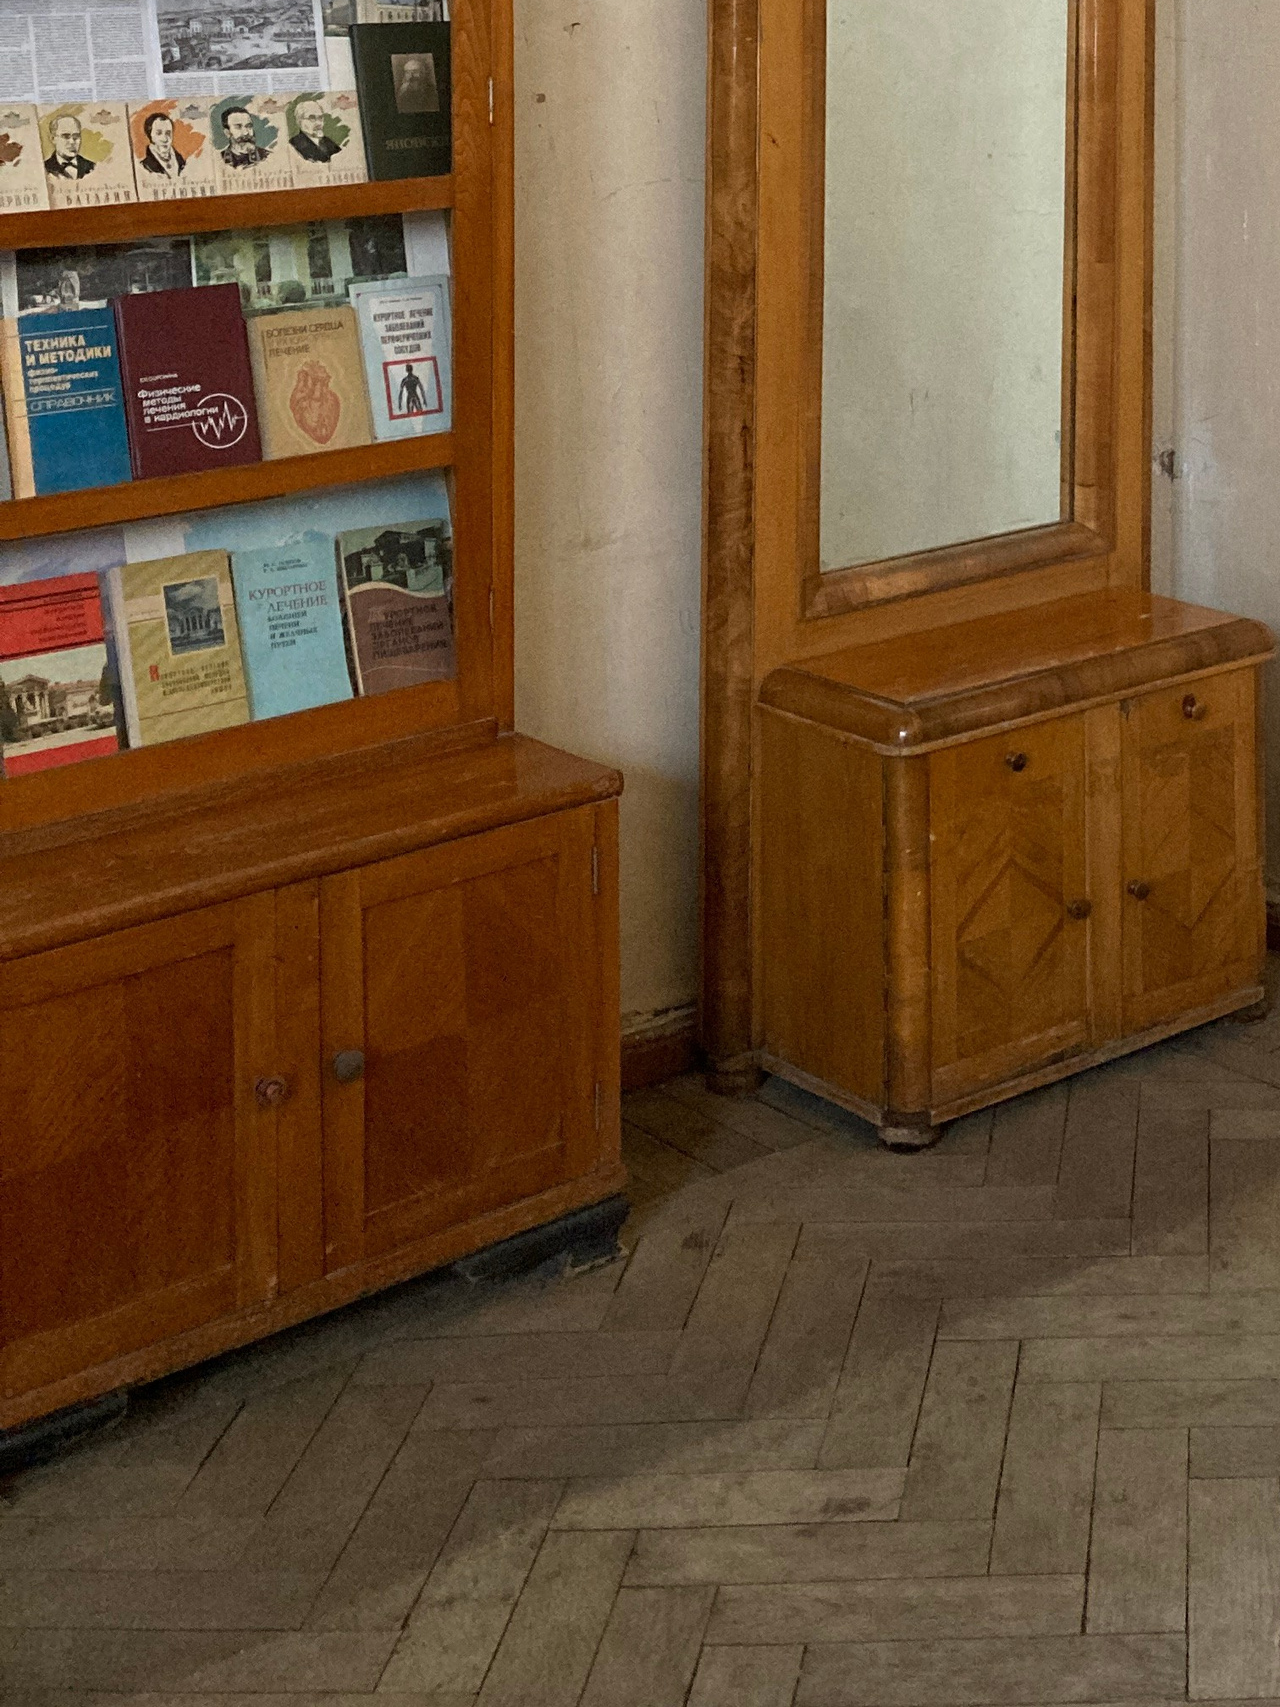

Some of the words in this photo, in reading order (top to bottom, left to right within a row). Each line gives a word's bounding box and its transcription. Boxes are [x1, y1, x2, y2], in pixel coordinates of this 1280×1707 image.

[24, 334, 86, 353] ТЕХНИКА
[25, 354, 36, 367] И
[38, 345, 112, 365] МЕТОДИКИ
[137, 384, 202, 399] Физические
[142, 395, 182, 408] методы
[143, 402, 187, 415] лечения
[153, 406, 219, 423] кардиологии
[248, 579, 328, 602] КУРОРТНОЕ
[266, 594, 328, 614] ЛЕЧЕНИЕ
